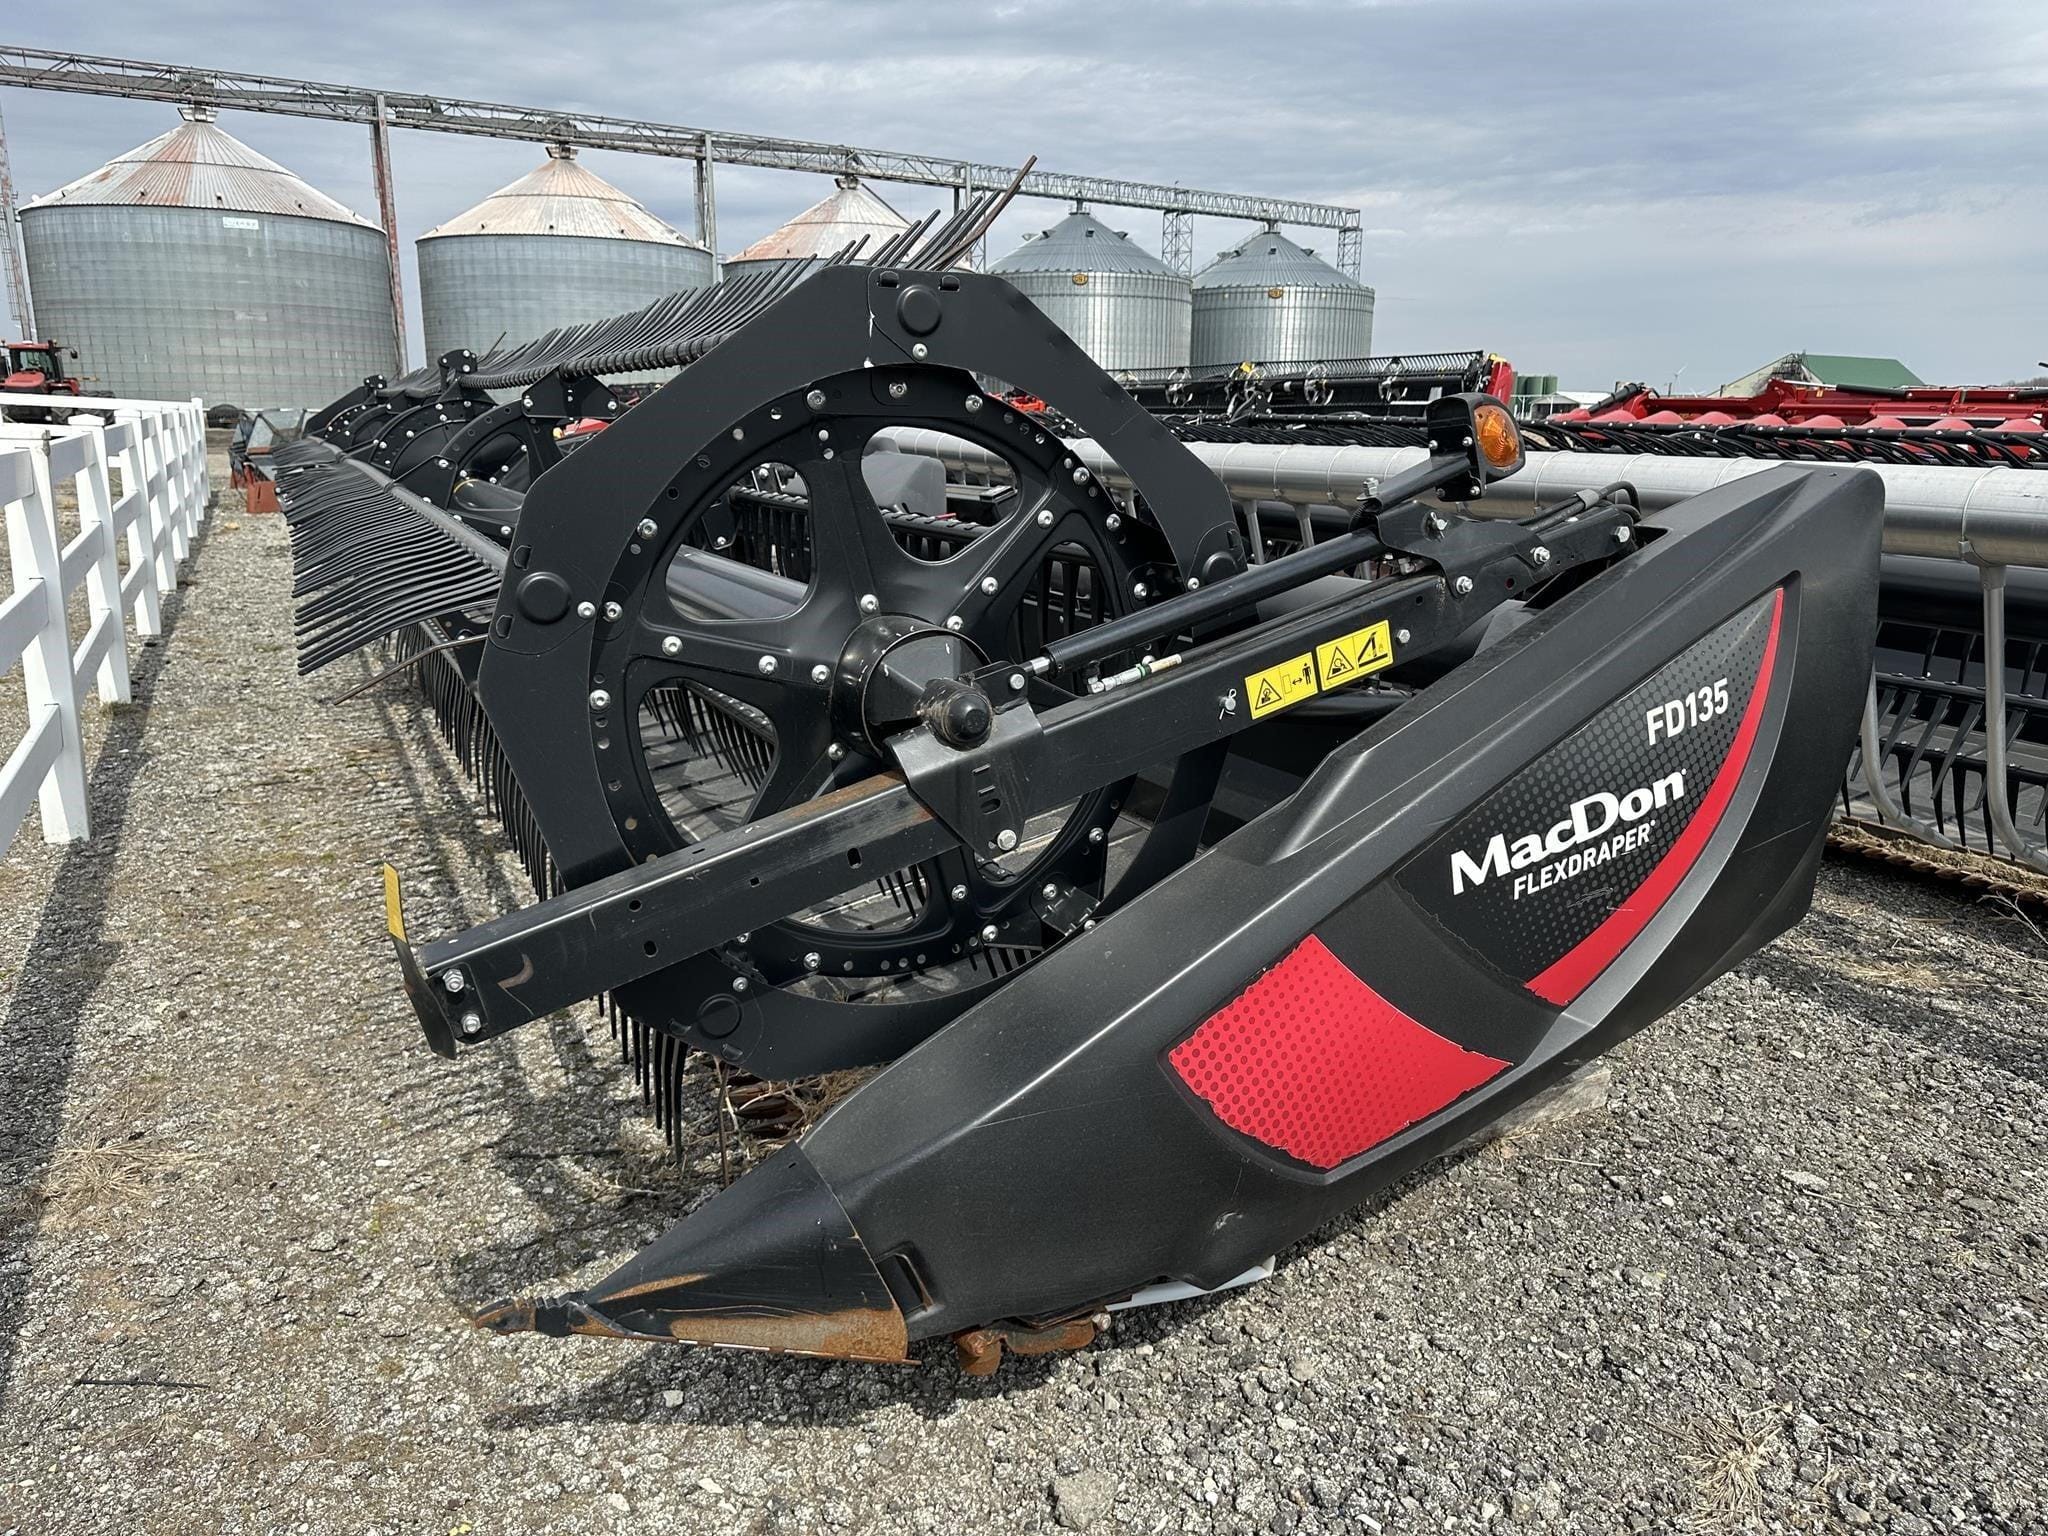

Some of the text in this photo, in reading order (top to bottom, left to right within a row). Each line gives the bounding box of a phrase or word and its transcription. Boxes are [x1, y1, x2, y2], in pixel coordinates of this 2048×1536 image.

[1646, 677, 1729, 746] FD135
[1450, 769, 1687, 896] MacDon
[1513, 820, 1656, 900] FLEXDRAPER
